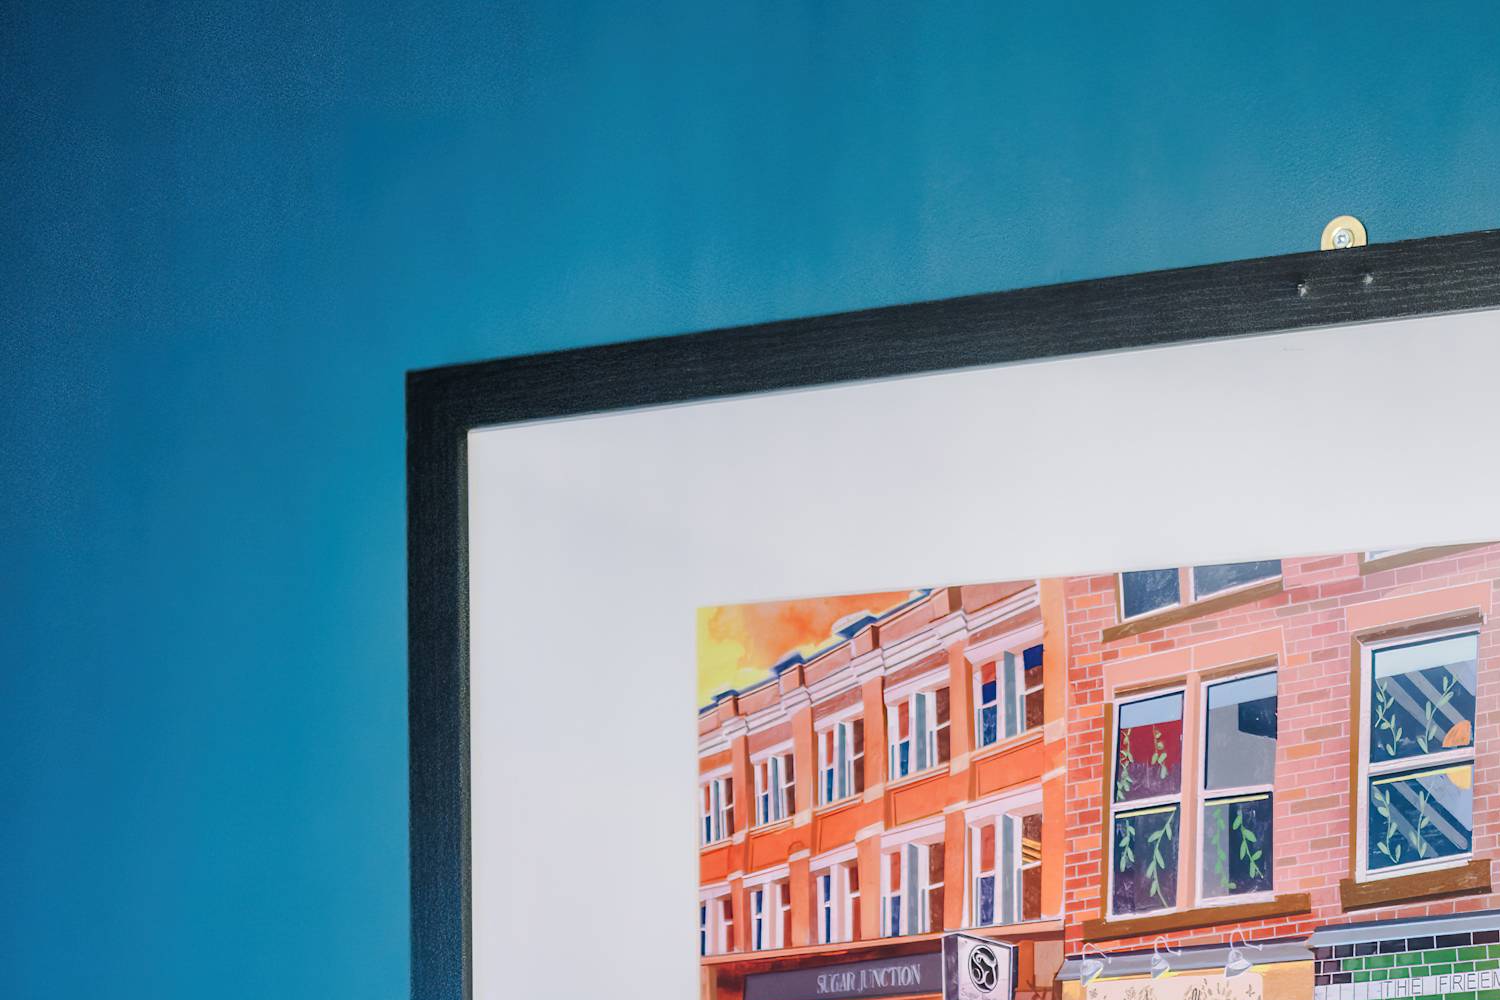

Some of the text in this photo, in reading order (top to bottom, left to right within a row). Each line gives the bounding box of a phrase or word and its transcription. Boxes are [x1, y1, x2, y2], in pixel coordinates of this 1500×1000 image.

[816, 964, 921, 994] SUGAR JUNCTION
[1380, 981, 1422, 996] THE
